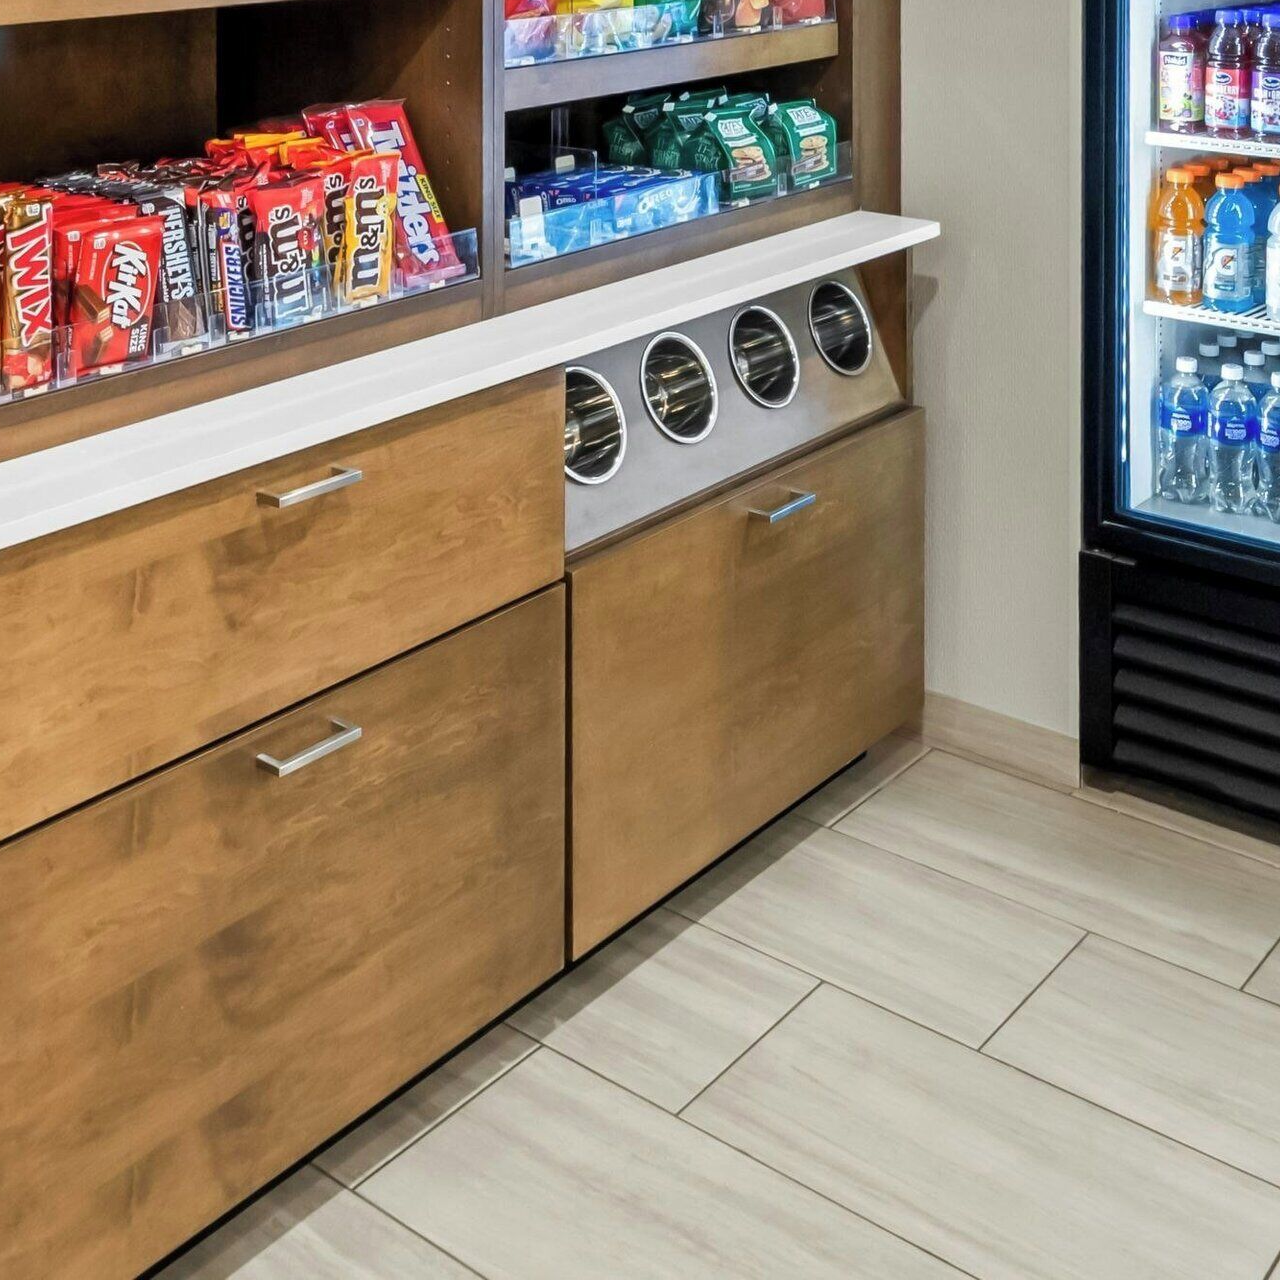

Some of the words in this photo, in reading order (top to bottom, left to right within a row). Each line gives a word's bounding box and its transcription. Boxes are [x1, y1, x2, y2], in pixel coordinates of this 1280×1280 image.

[420, 177, 433, 200] KING
[428, 199, 442, 219] SIZE
[556, 197, 576, 206] OREO
[163, 205, 194, 300] HERSHEY'S
[352, 177, 386, 290] m&m's
[6, 203, 53, 347] TWIX
[223, 245, 246, 329] SNICKERS
[129, 327, 139, 353] SIZE
[137, 323, 148, 352] KING
